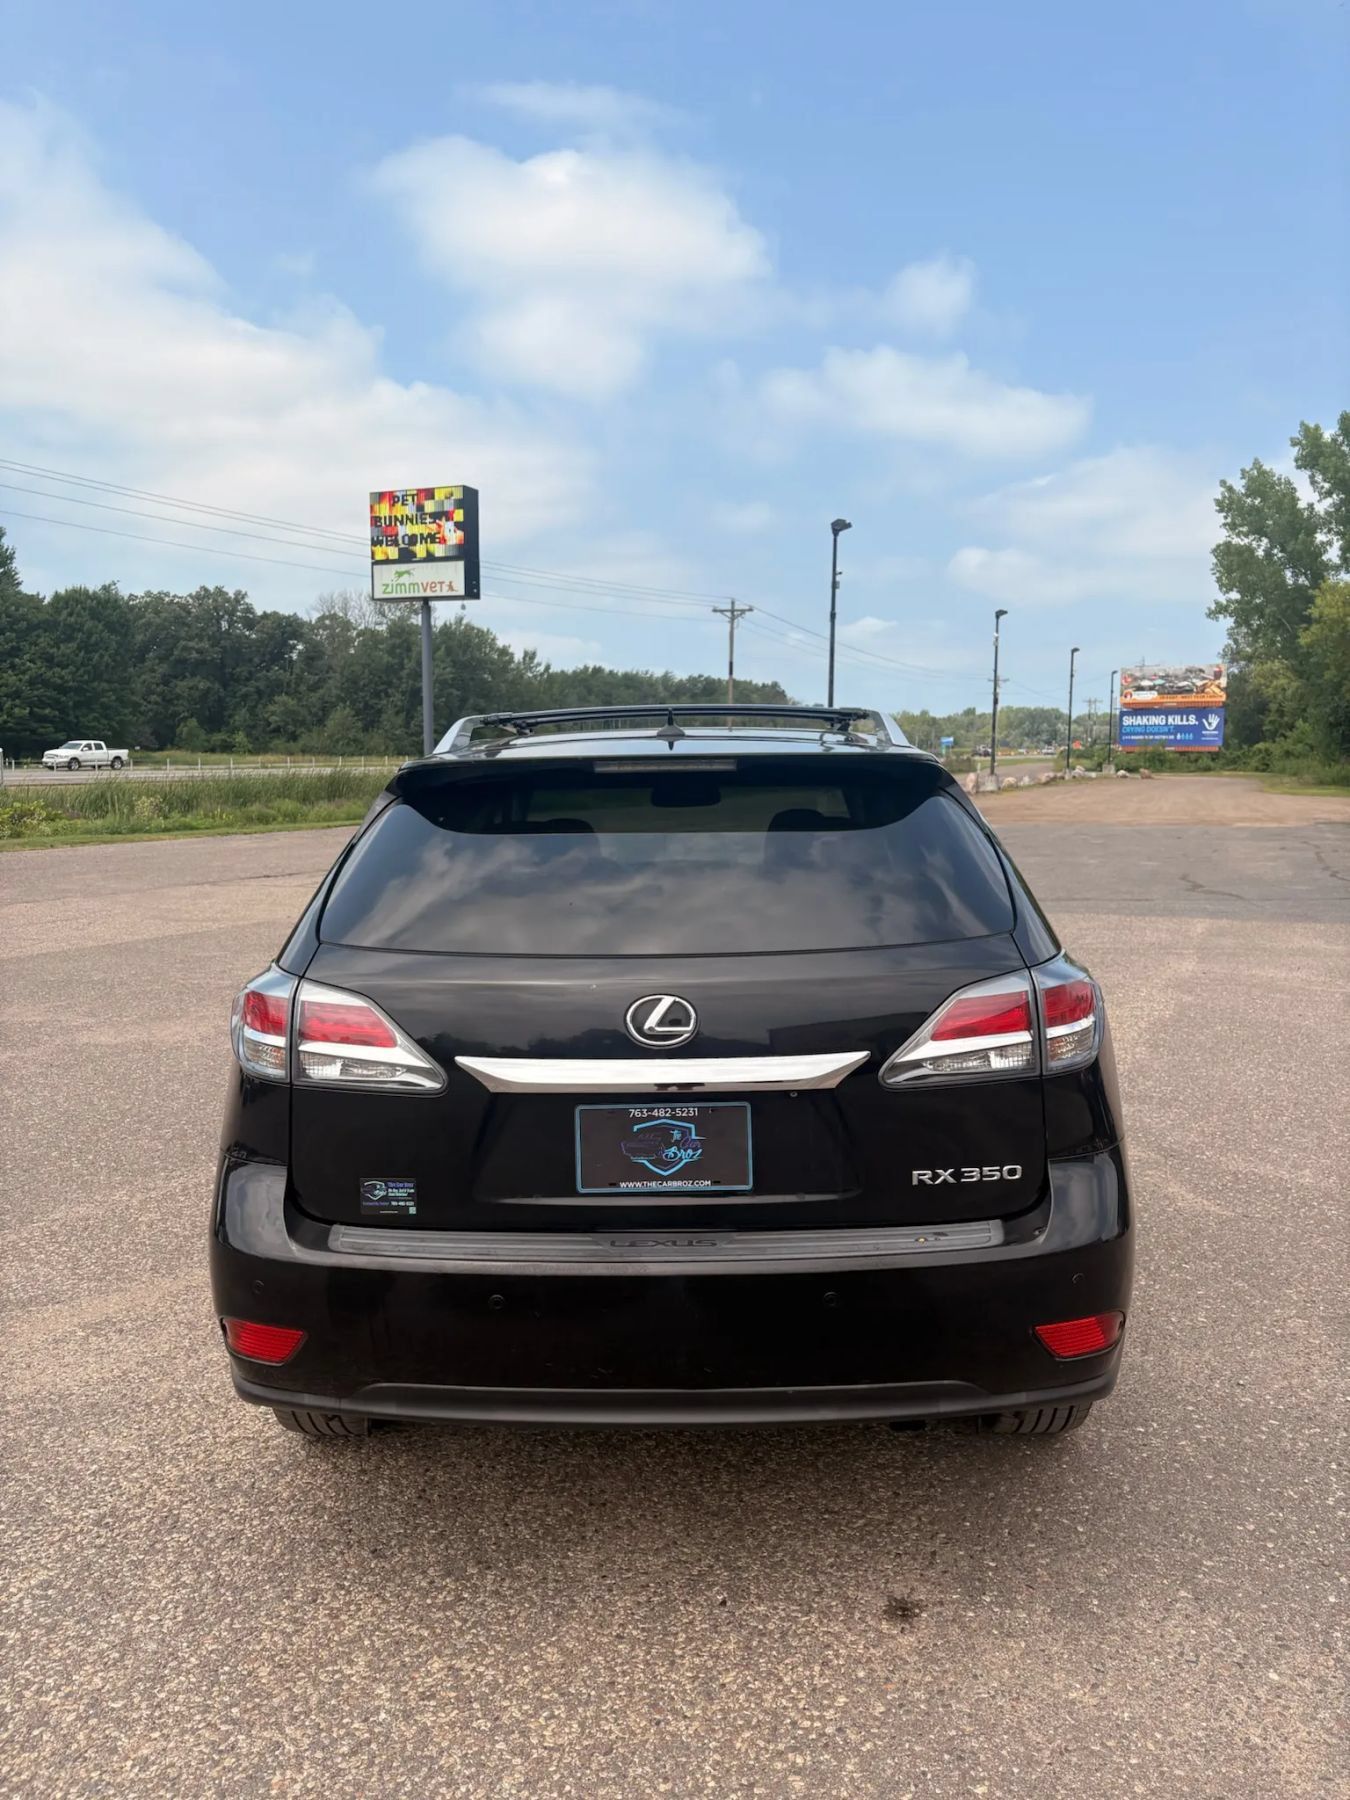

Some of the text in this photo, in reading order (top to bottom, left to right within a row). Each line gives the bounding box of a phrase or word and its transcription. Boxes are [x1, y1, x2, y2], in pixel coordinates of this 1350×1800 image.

[392, 493, 417, 507] PET
[371, 531, 440, 547] WELCOME
[1122, 713, 1199, 727] SHAKING KILLS.
[628, 1107, 699, 1118] 763-482-5231
[911, 1164, 1023, 1186] RX 350
[619, 1179, 712, 1189] WWW.THECARBROZ.COM
[610, 1239, 718, 1248] LEXUS
